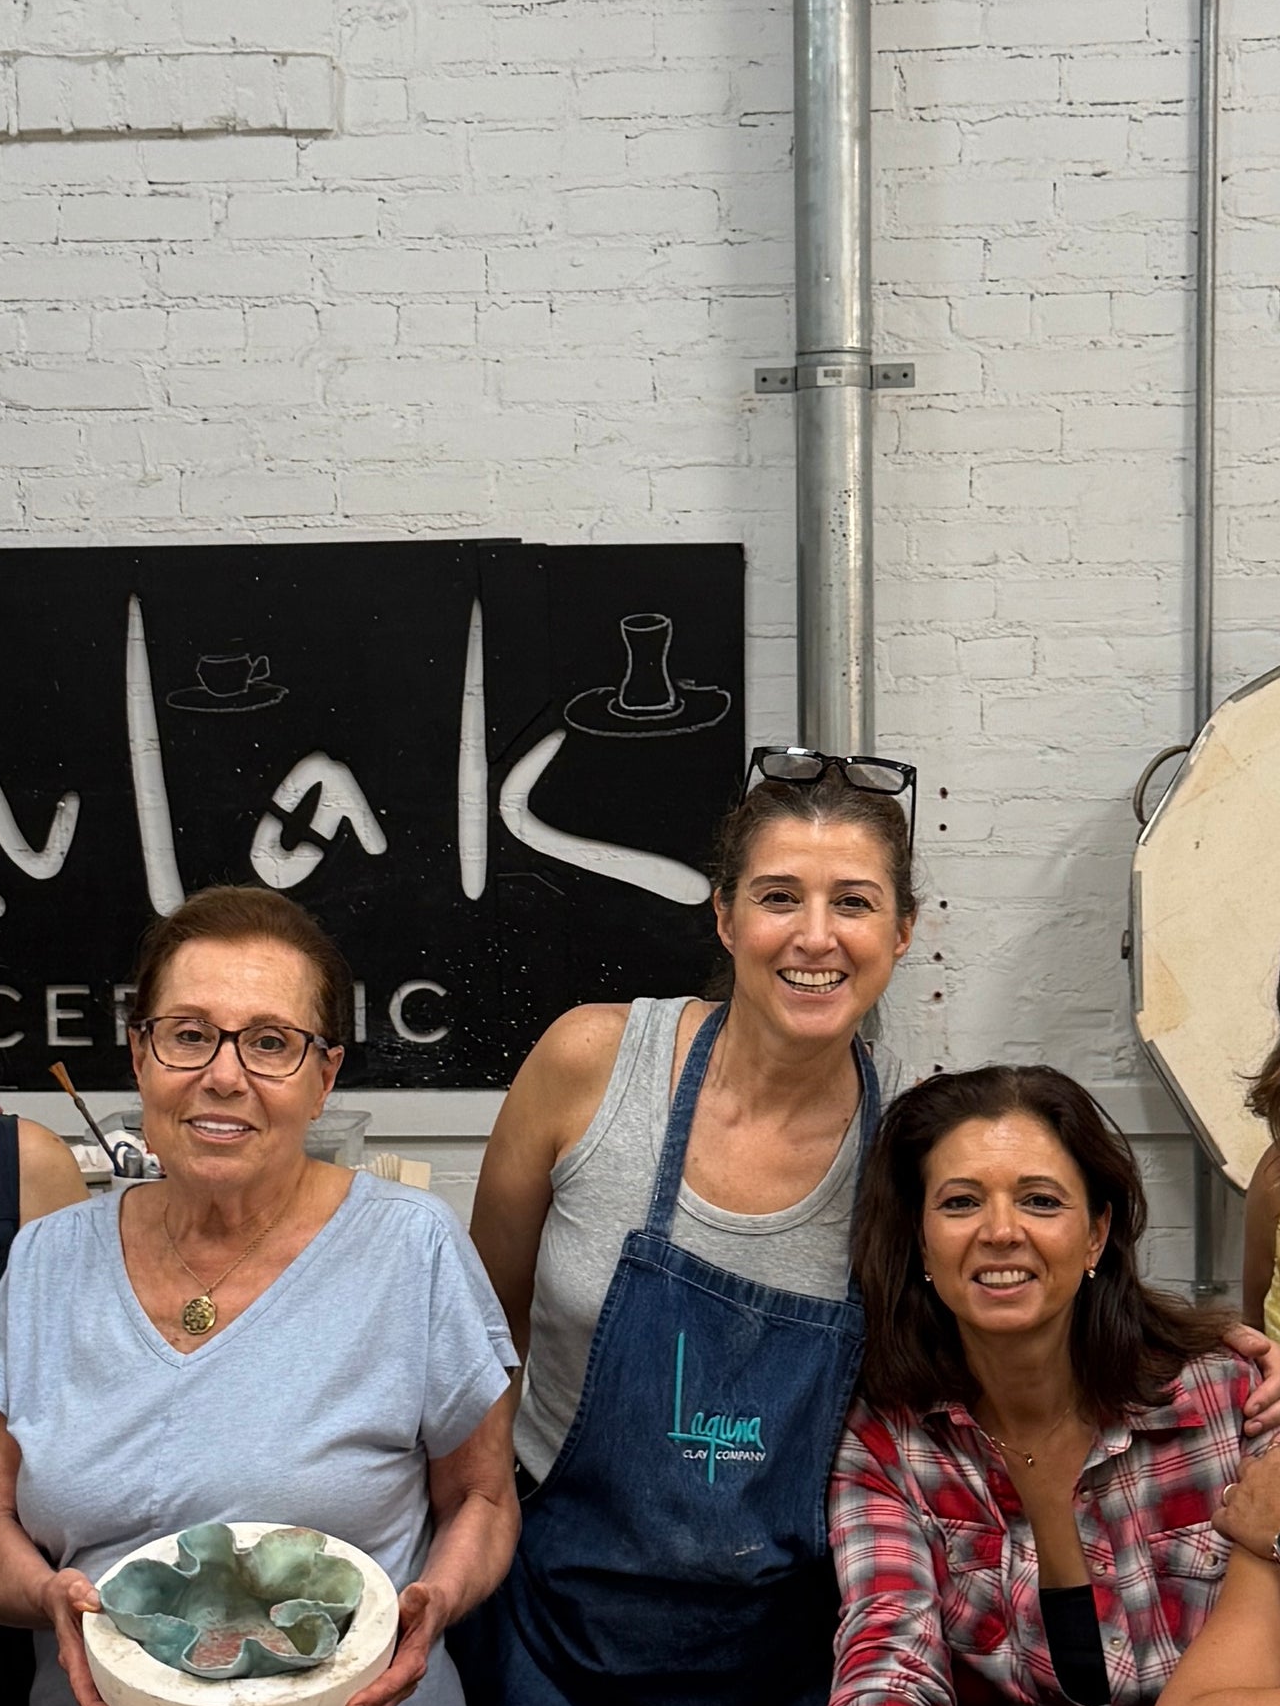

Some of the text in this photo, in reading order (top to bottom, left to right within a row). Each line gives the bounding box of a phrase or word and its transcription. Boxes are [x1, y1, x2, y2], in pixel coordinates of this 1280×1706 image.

[666, 1330, 766, 1486] Laguna
[682, 1449, 766, 1462] CLAY COMPANY
